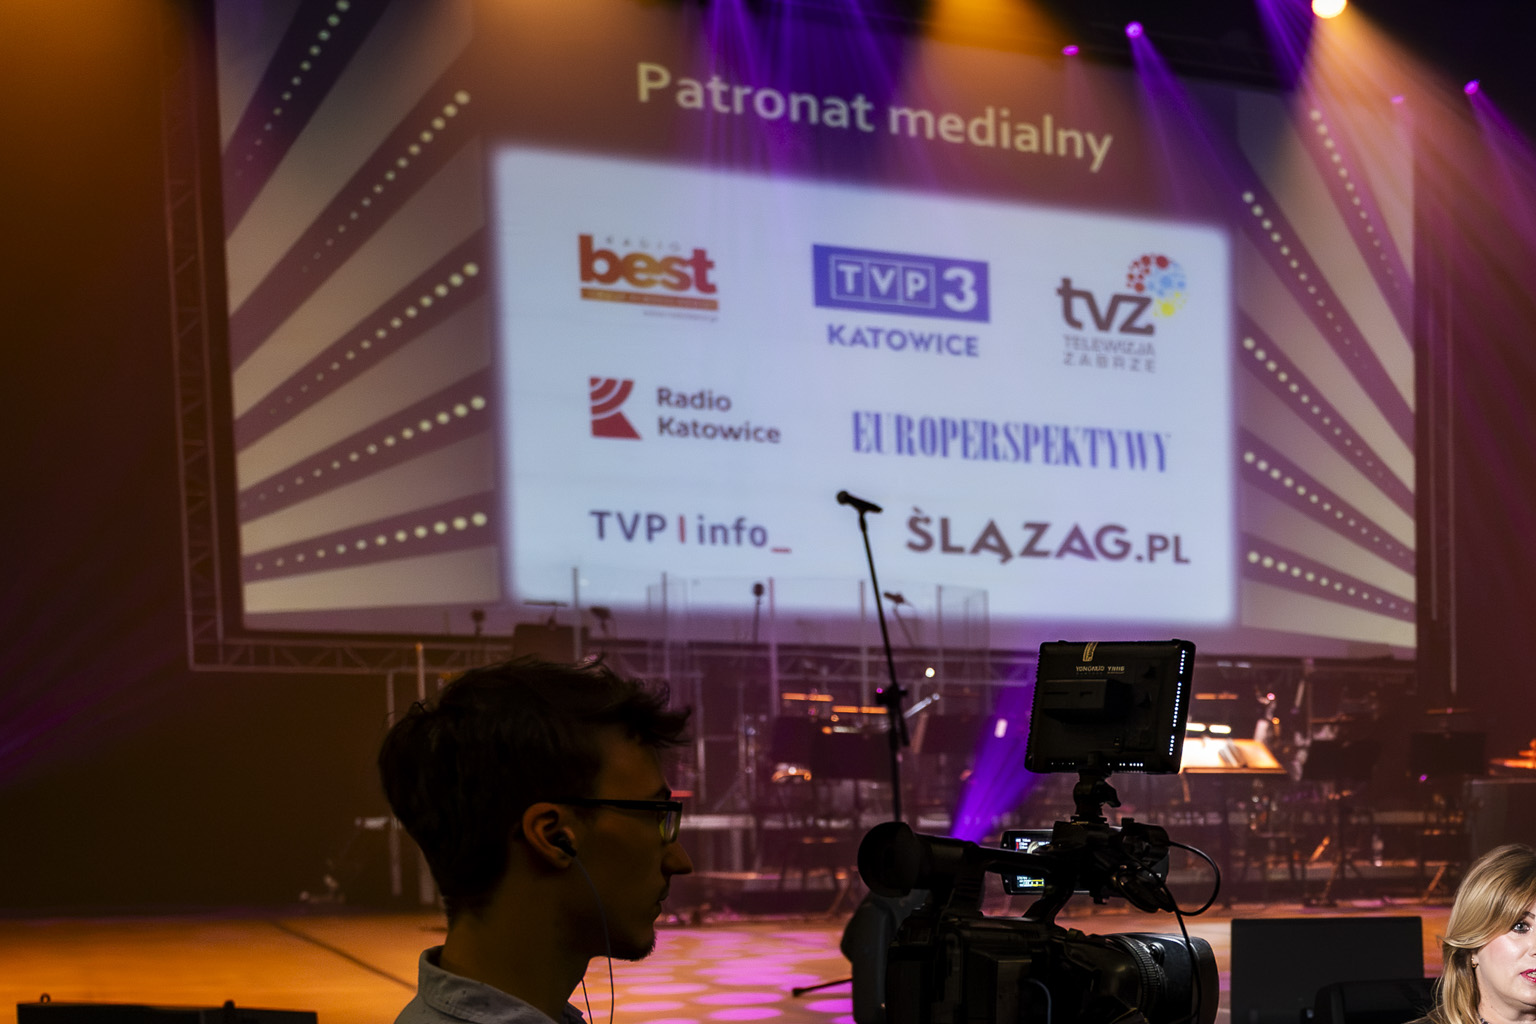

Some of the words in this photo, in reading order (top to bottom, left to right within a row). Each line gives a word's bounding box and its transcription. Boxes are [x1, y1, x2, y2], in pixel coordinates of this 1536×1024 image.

[636, 62, 875, 133] Patronat
[888, 107, 1113, 173] medialny
[578, 233, 717, 294] best
[827, 323, 980, 358] KATOWICE
[1063, 334, 1156, 356] TELEWIZJA
[1063, 351, 1156, 373] ZABRZE
[656, 386, 733, 413] Radio
[658, 416, 782, 444] Katowice
[852, 410, 1172, 473] EUROPERSPEKTYWY
[589, 509, 668, 543] TVP
